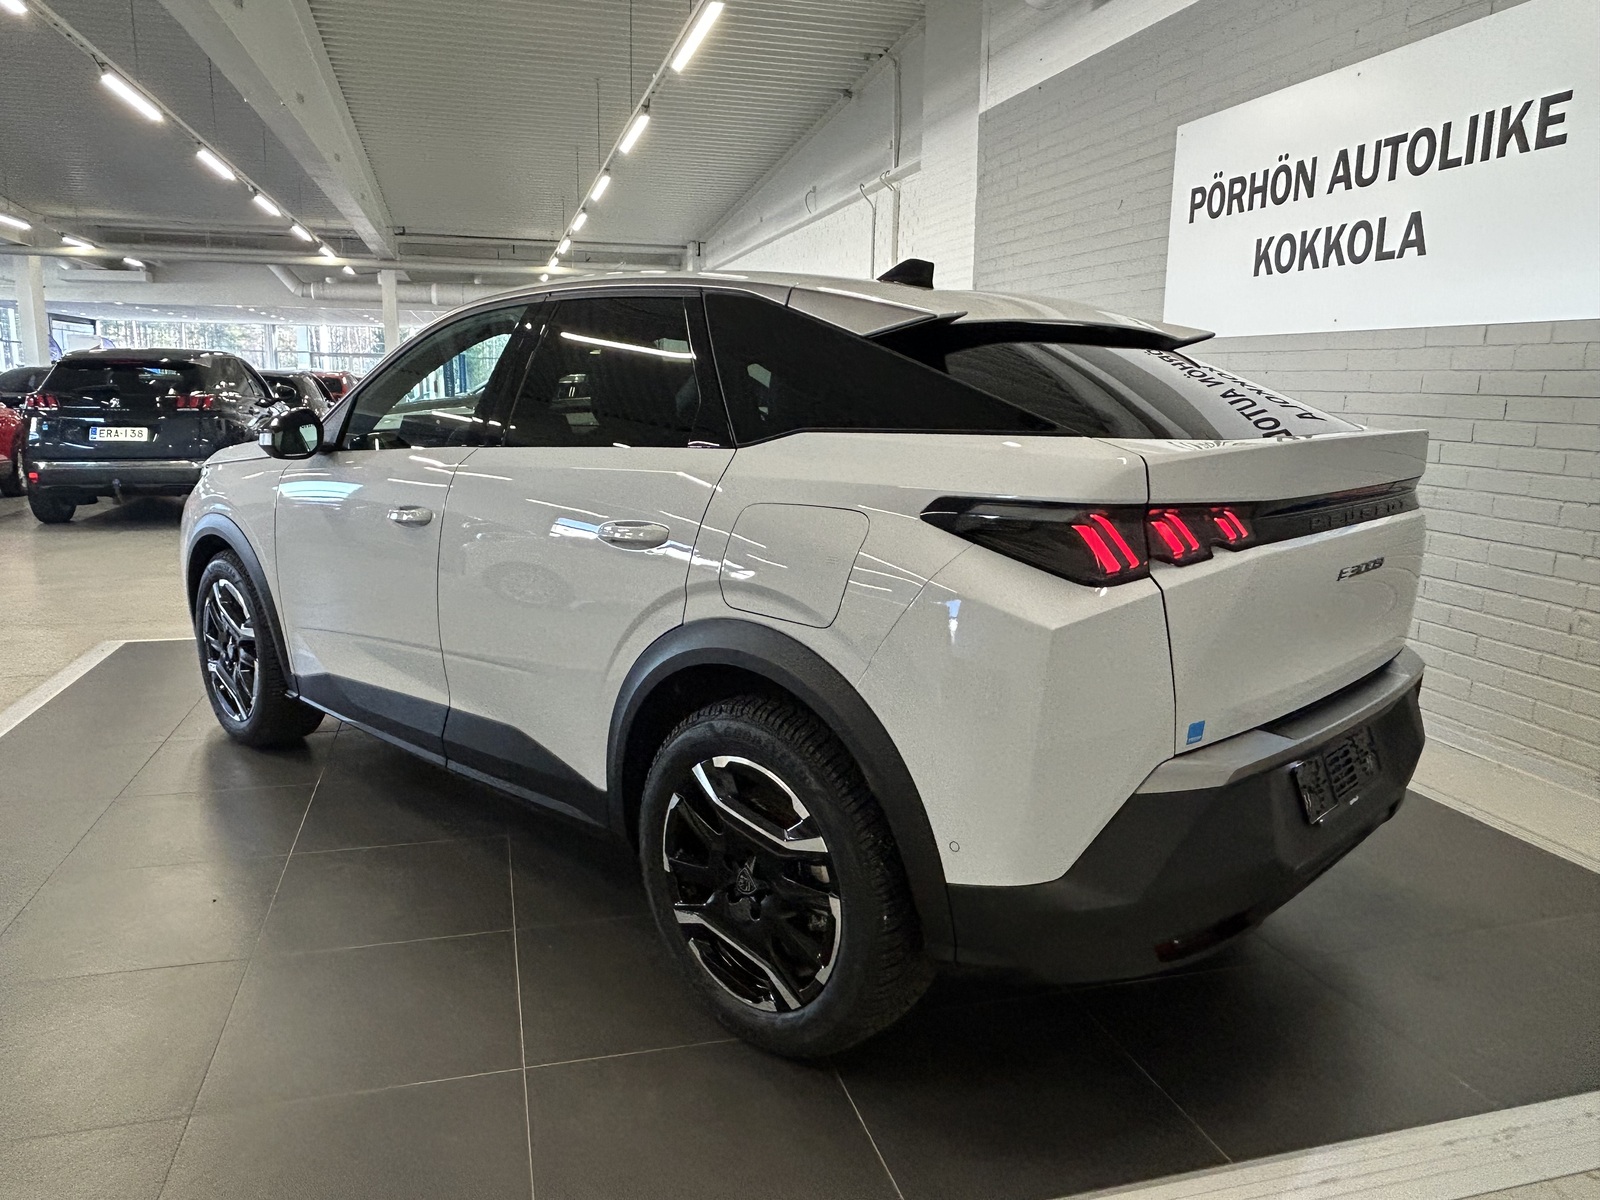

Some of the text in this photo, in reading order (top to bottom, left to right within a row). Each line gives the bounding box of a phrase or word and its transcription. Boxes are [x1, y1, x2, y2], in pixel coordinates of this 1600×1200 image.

[1188, 89, 1574, 224] PÖRHÖN AUTOLIIKE
[1253, 210, 1427, 278] KOKKOLA
[98, 428, 144, 438] ERA-138
